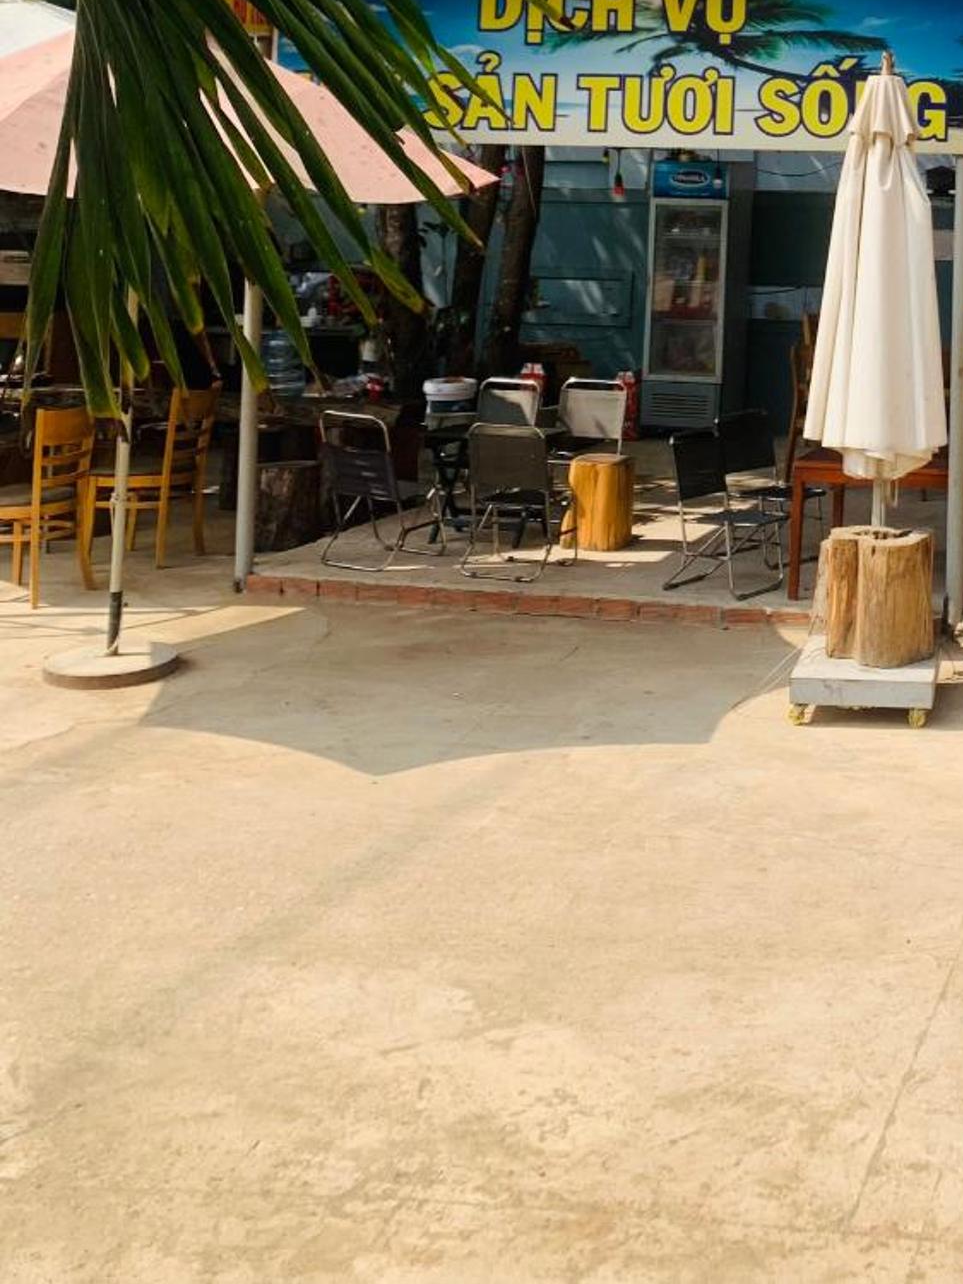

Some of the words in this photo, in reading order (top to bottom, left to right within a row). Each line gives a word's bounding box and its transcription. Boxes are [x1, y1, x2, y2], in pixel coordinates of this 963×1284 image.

[422, 50, 558, 132] SẢN
[577, 61, 734, 136] TƯƠI
[754, 57, 949, 142] SỐG
